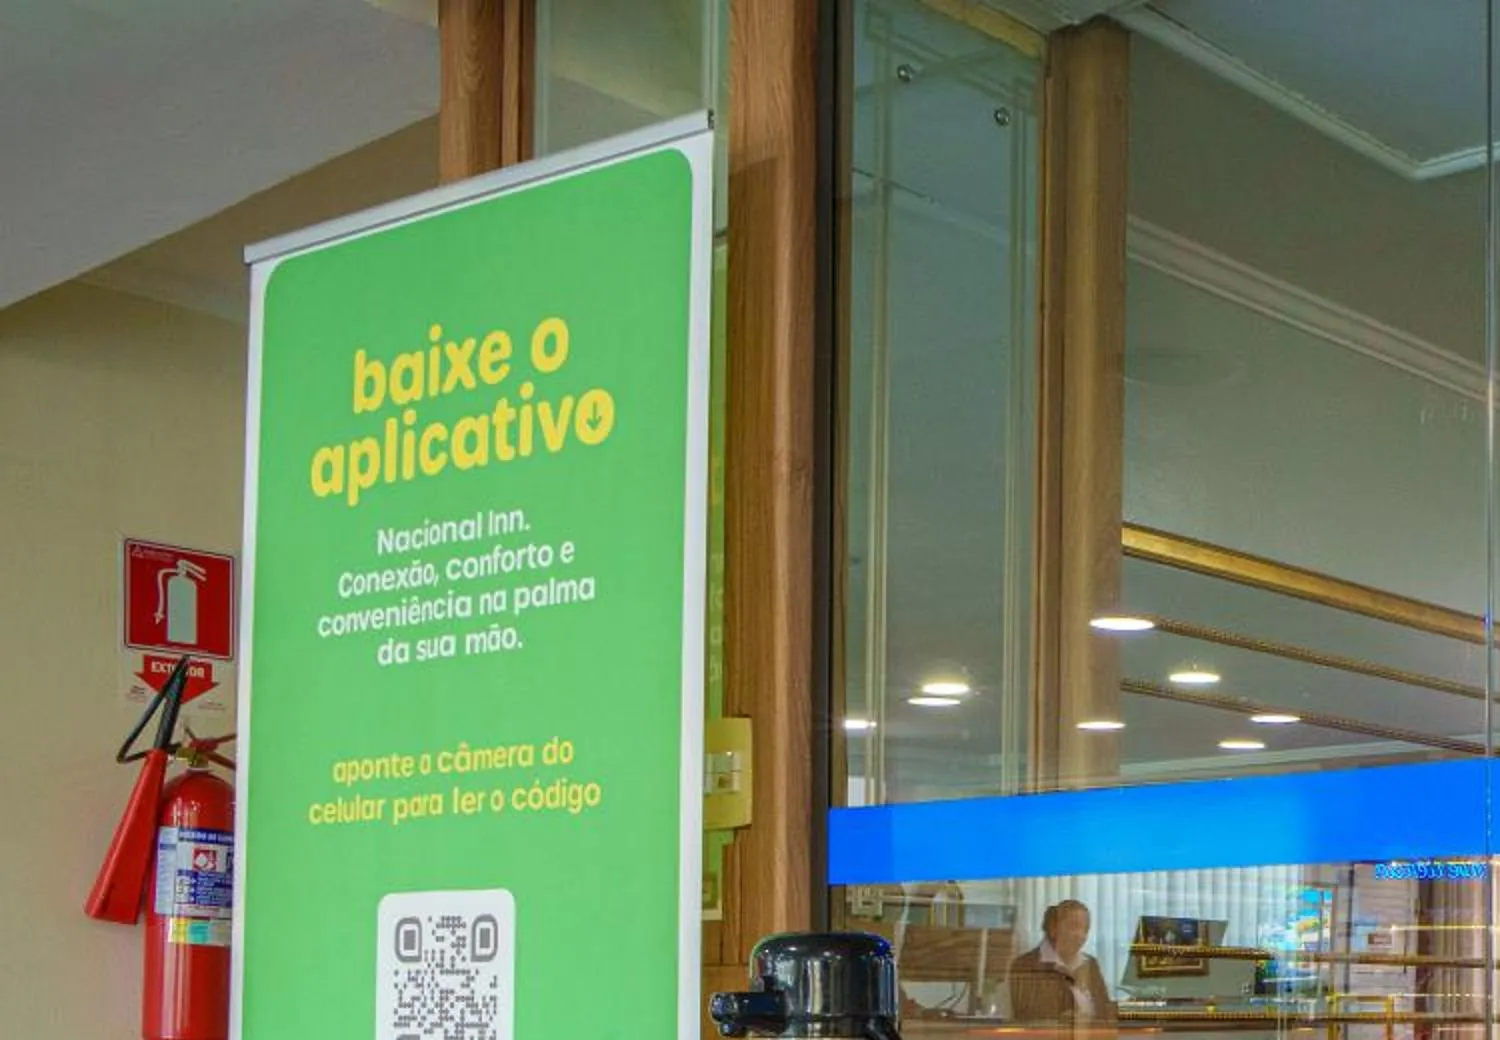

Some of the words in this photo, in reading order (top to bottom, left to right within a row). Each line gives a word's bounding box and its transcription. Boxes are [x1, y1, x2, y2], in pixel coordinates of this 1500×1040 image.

[353, 324, 512, 414] baixe
[530, 317, 569, 374] o
[310, 381, 616, 507] aplicativo
[376, 512, 482, 555] Nacional
[488, 508, 531, 536] Inn.
[338, 560, 439, 598] Conexão,
[446, 545, 553, 581] conforto
[560, 540, 575, 564] e
[318, 594, 472, 637] conveniência
[479, 588, 507, 613] na
[514, 577, 596, 616] palma
[151, 660, 205, 678] EXTIOR
[377, 638, 410, 666] da
[416, 636, 456, 663] sua
[465, 623, 523, 656] mão.
[333, 753, 414, 787] aponte
[437, 742, 534, 775] câmera
[542, 736, 574, 764] do
[309, 794, 386, 825] celular
[393, 791, 444, 825] para
[453, 787, 487, 814] ler
[490, 788, 505, 812] o
[511, 779, 602, 814] código
